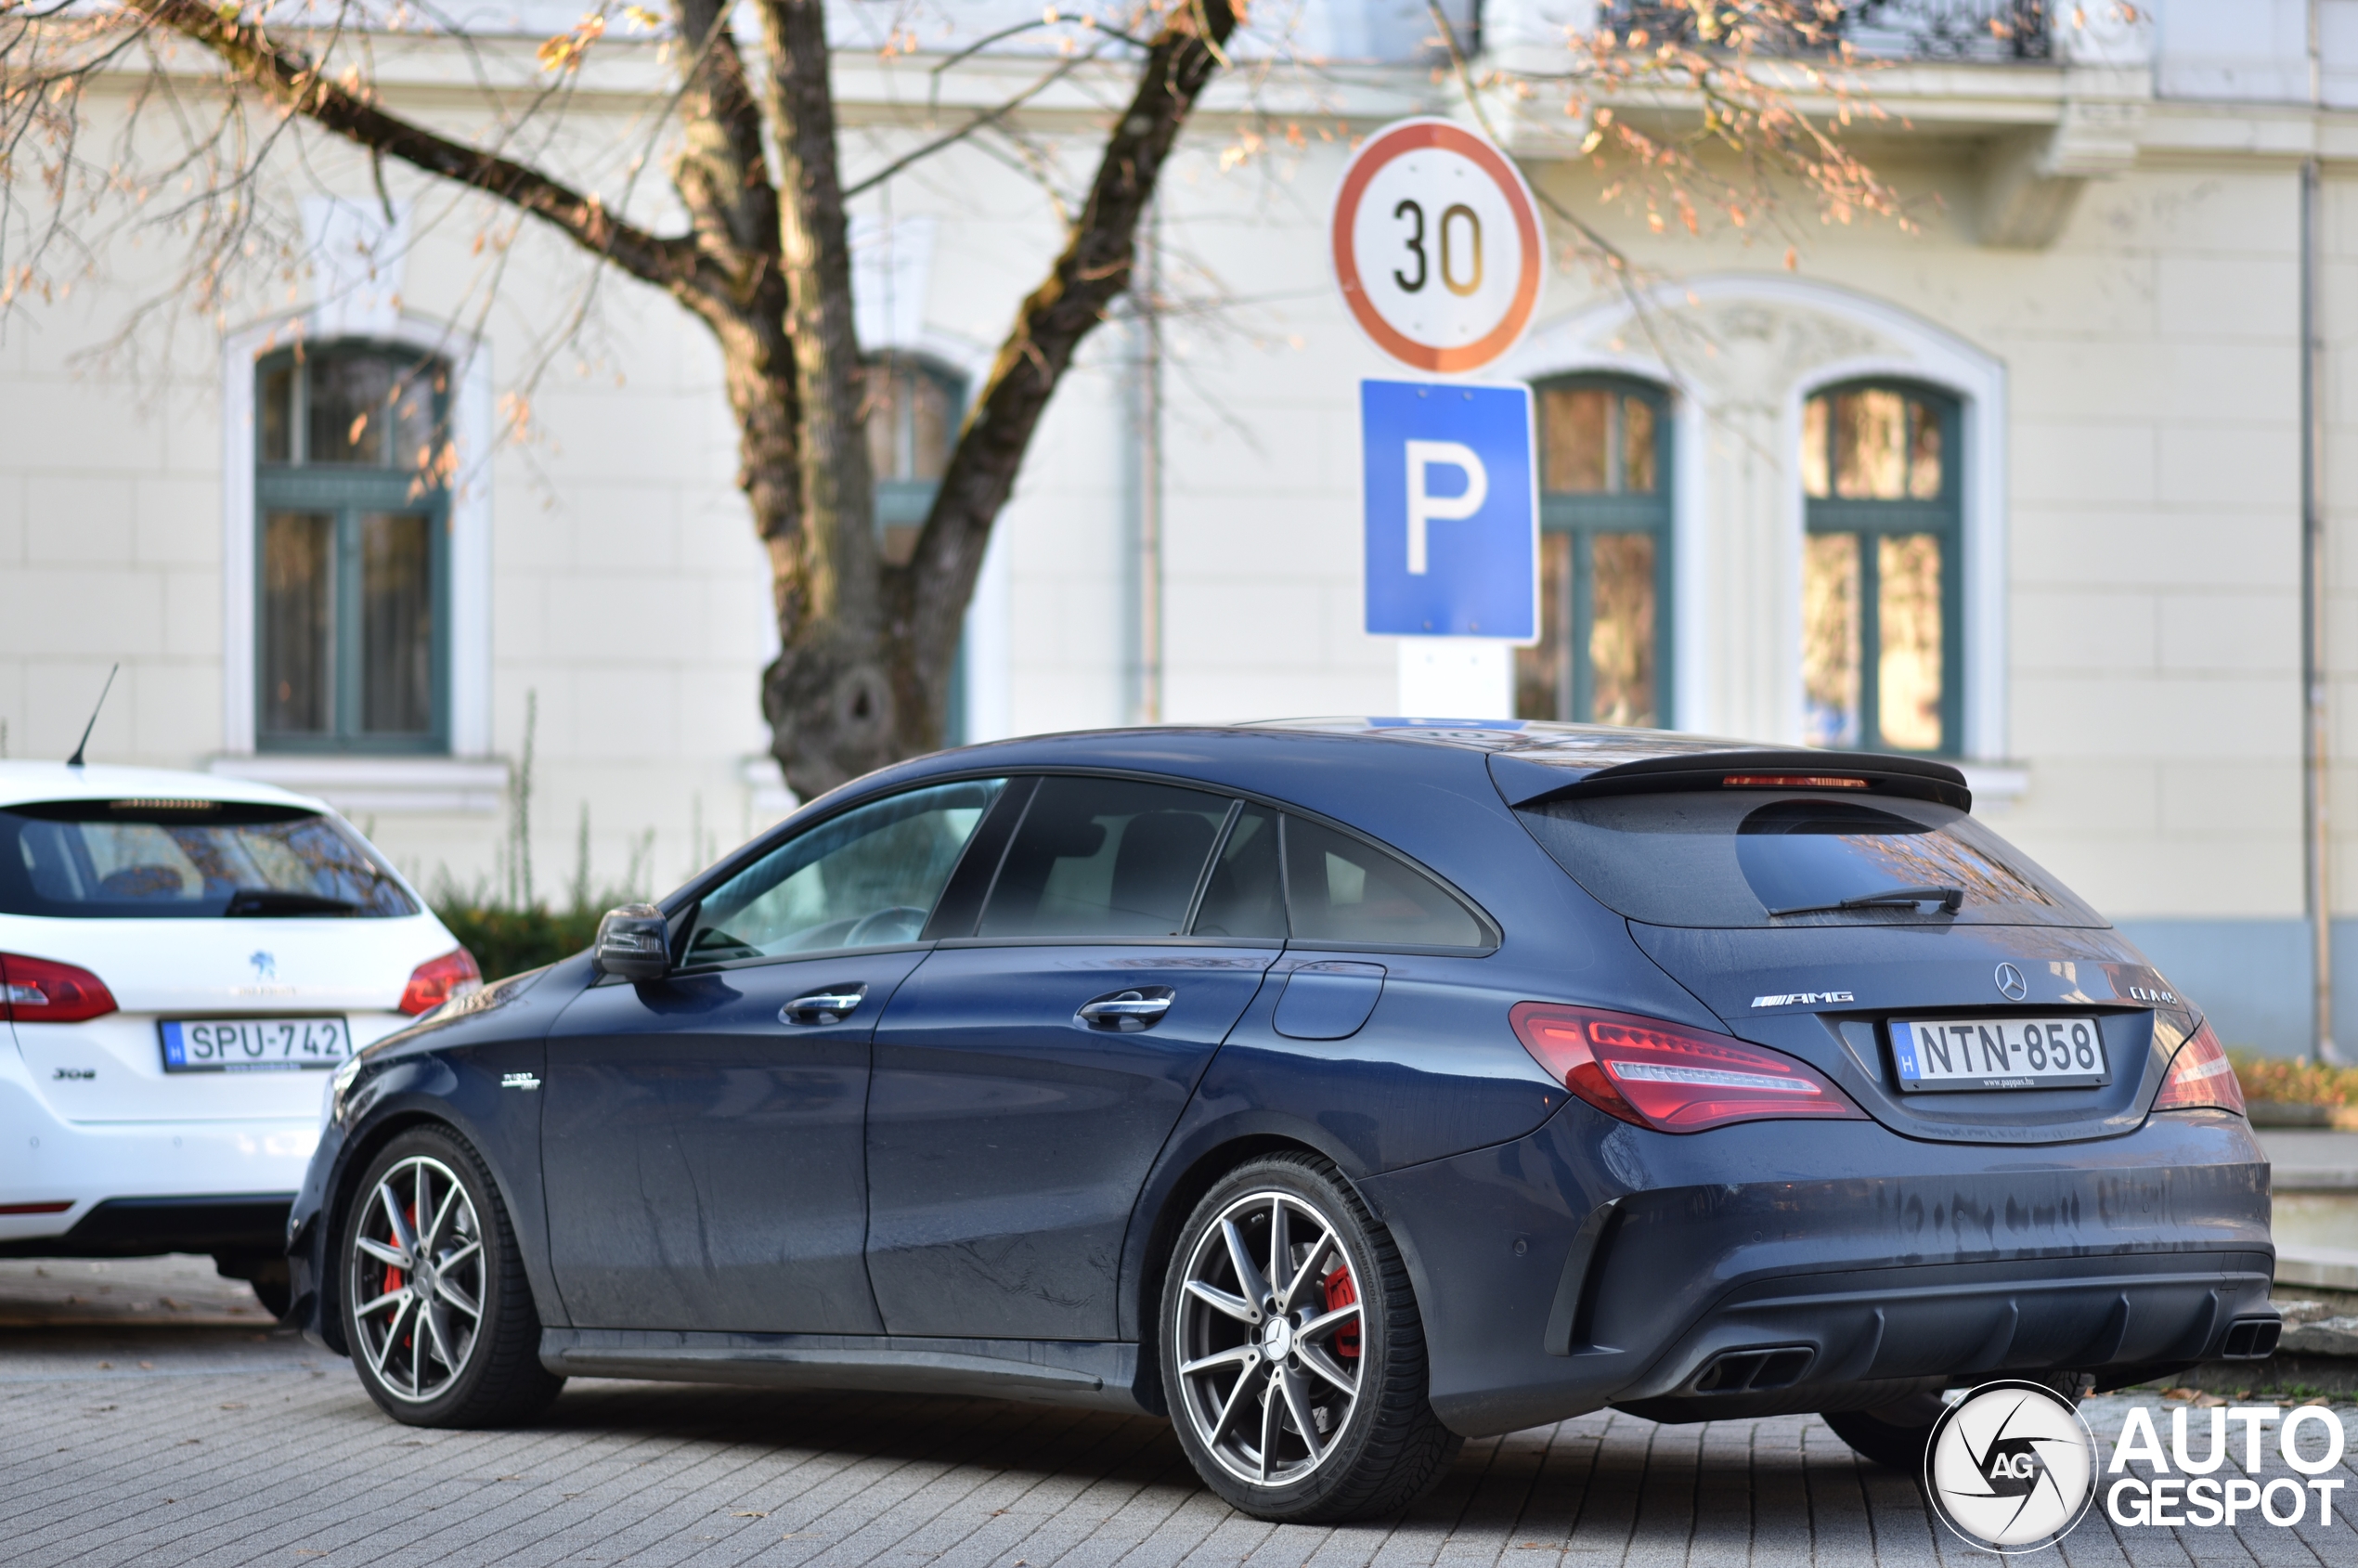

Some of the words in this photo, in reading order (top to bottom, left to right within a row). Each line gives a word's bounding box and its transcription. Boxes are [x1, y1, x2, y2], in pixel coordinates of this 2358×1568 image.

[1393, 199, 1483, 297] 30
[1406, 439, 1488, 575] P
[1785, 991, 1855, 1005] AMG
[171, 1046, 182, 1061] H
[192, 1024, 341, 1058] SPU-742
[1921, 1023, 2095, 1073] NTN-858
[1901, 1056, 1914, 1072] H
[1983, 1077, 2035, 1088] www.pappas.hu
